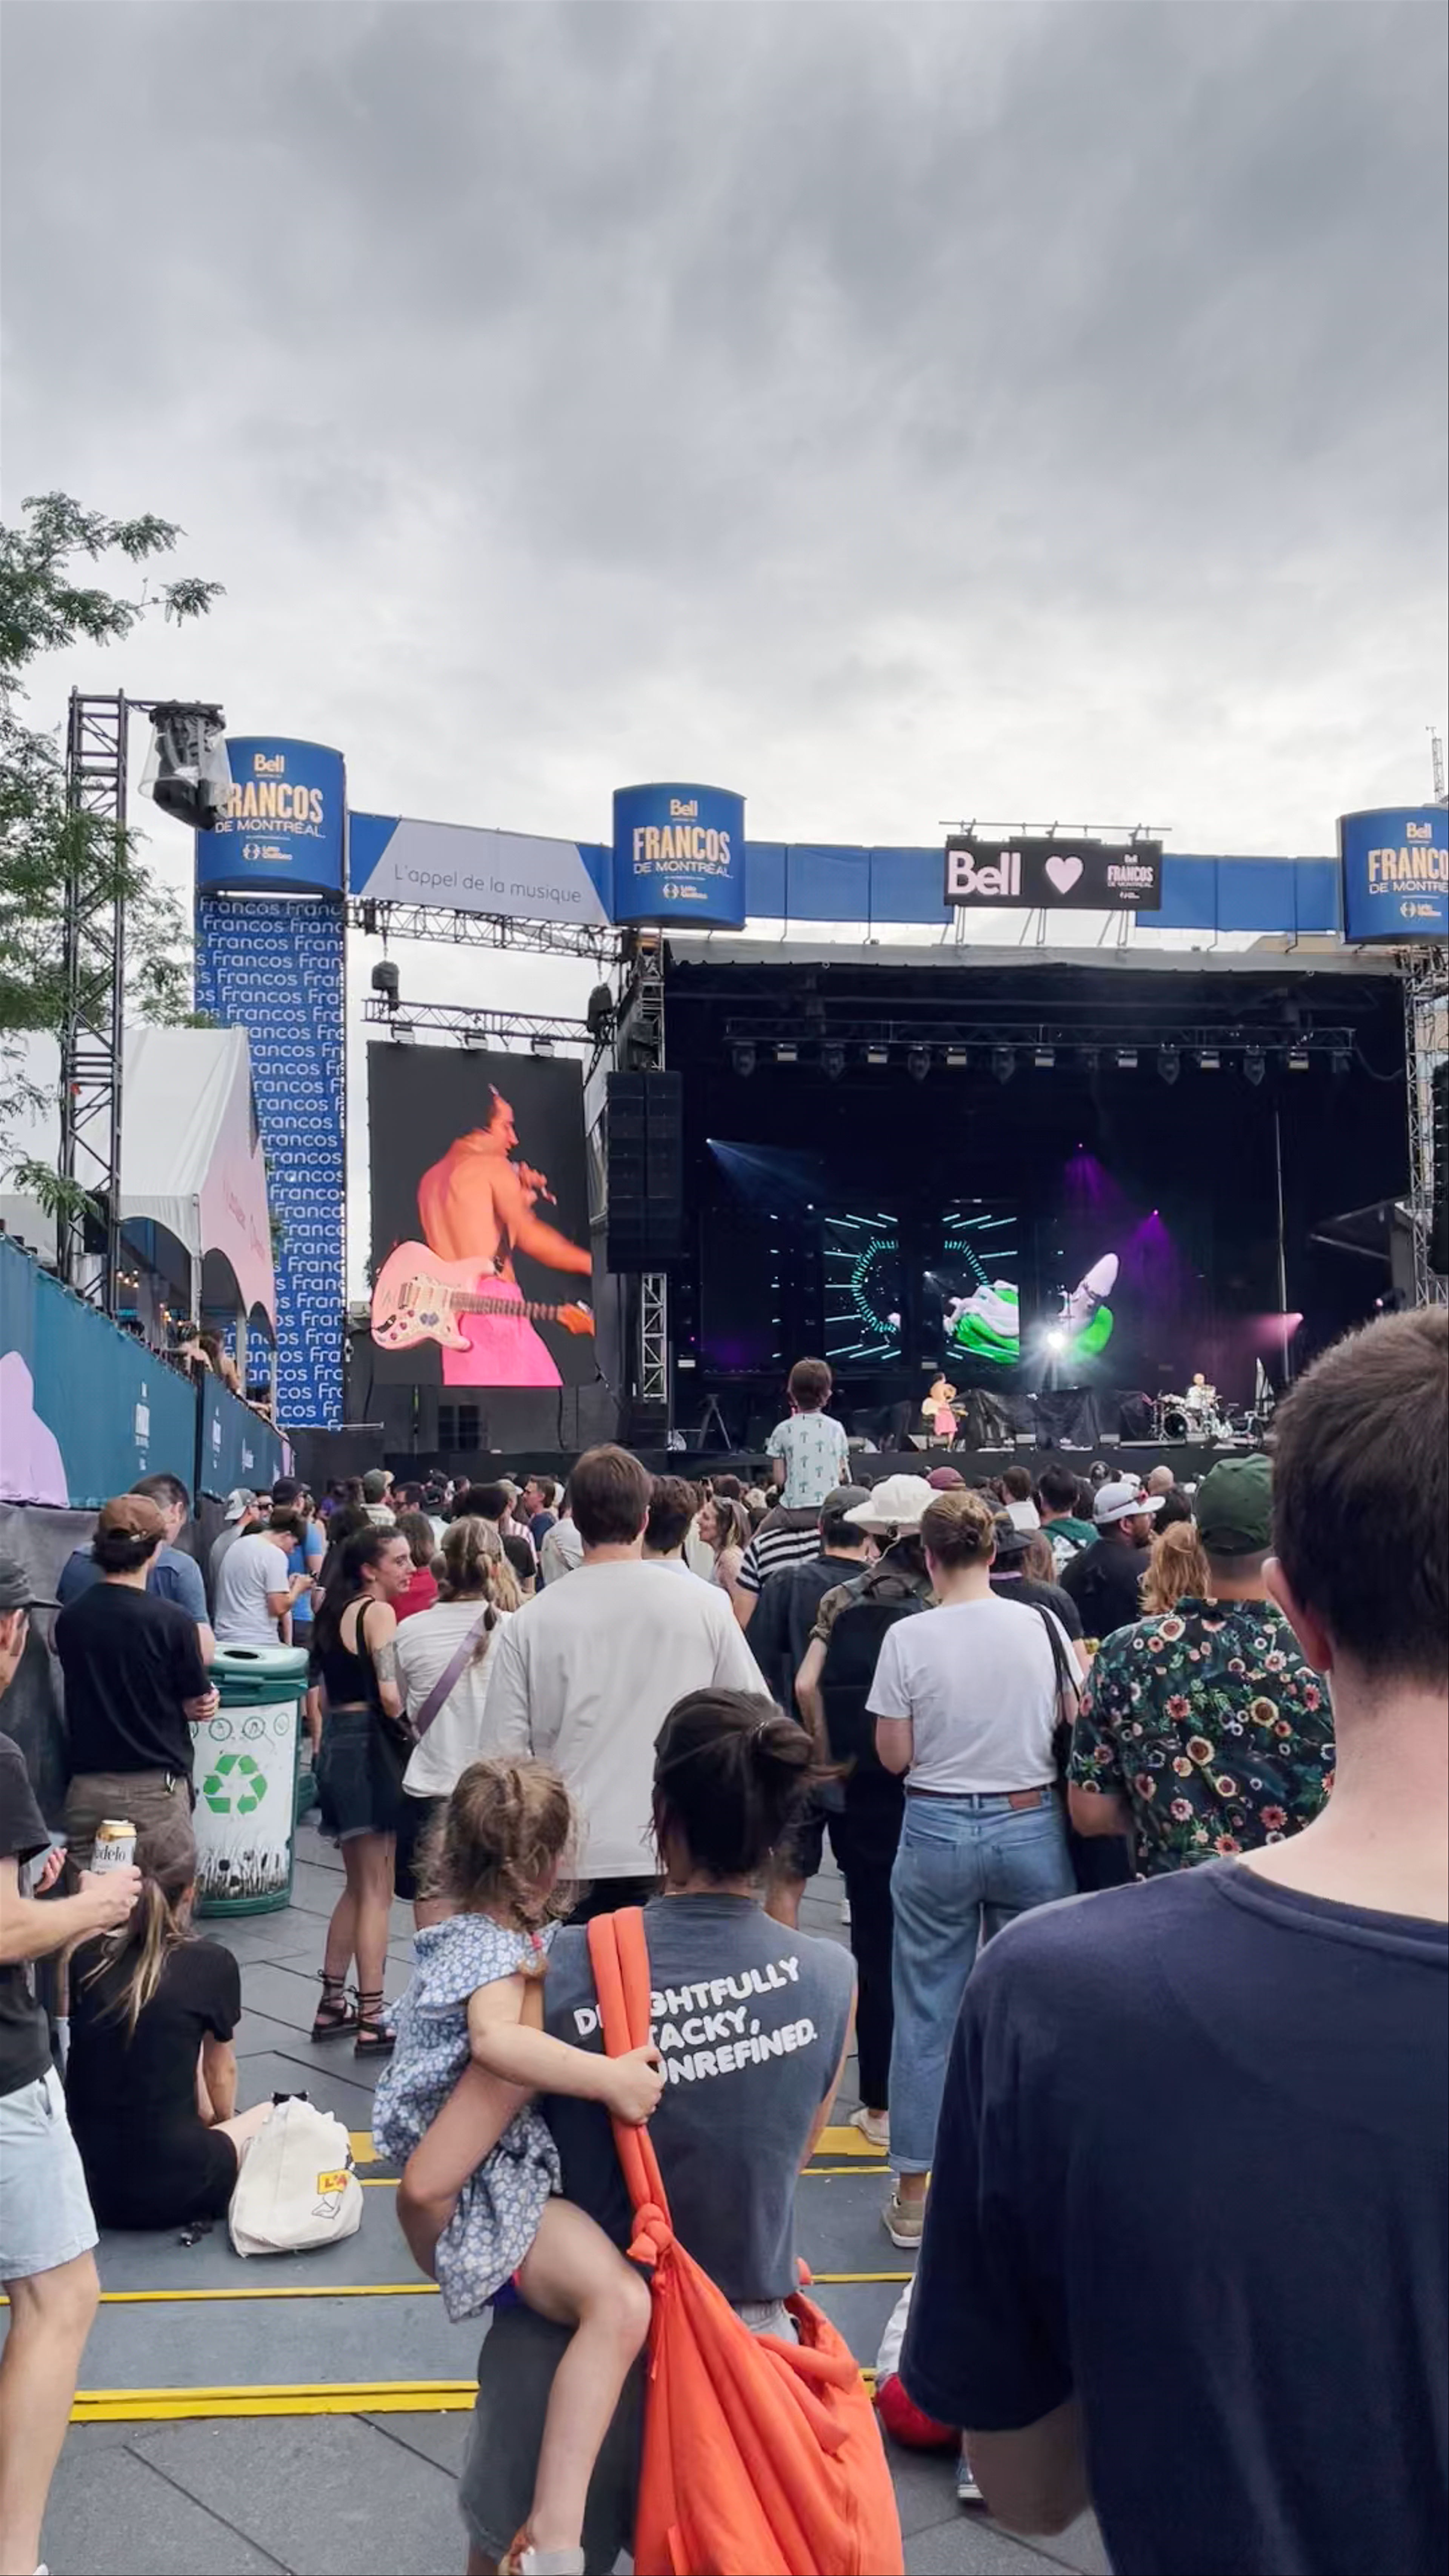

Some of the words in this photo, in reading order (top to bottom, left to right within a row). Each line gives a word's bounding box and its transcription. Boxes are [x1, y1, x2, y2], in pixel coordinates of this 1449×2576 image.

[254, 754, 284, 773] Bell
[227, 781, 323, 824] RANCOS
[670, 799, 698, 817] Bell
[215, 821, 233, 833] DE
[1406, 821, 1432, 839] Bell
[633, 826, 731, 864] FRANCOS
[634, 862, 652, 874] DE
[947, 850, 1021, 896] Bell
[394, 864, 457, 887] L'appel
[463, 874, 484, 891] de
[490, 877, 505, 893] la
[510, 881, 581, 904] musique
[1369, 882, 1389, 894] DE
[200, 896, 280, 915] Francos
[203, 914, 284, 933] Francos
[208, 932, 289, 950] Francos
[212, 950, 293, 968] Francos
[217, 967, 298, 986] Francos
[222, 985, 302, 1004] Francos
[227, 1003, 306, 1022] Francos
[253, 1077, 324, 1093] rancos
[255, 1094, 328, 1111] rancos
[574, 1956, 799, 2036] DGHTFULLY
